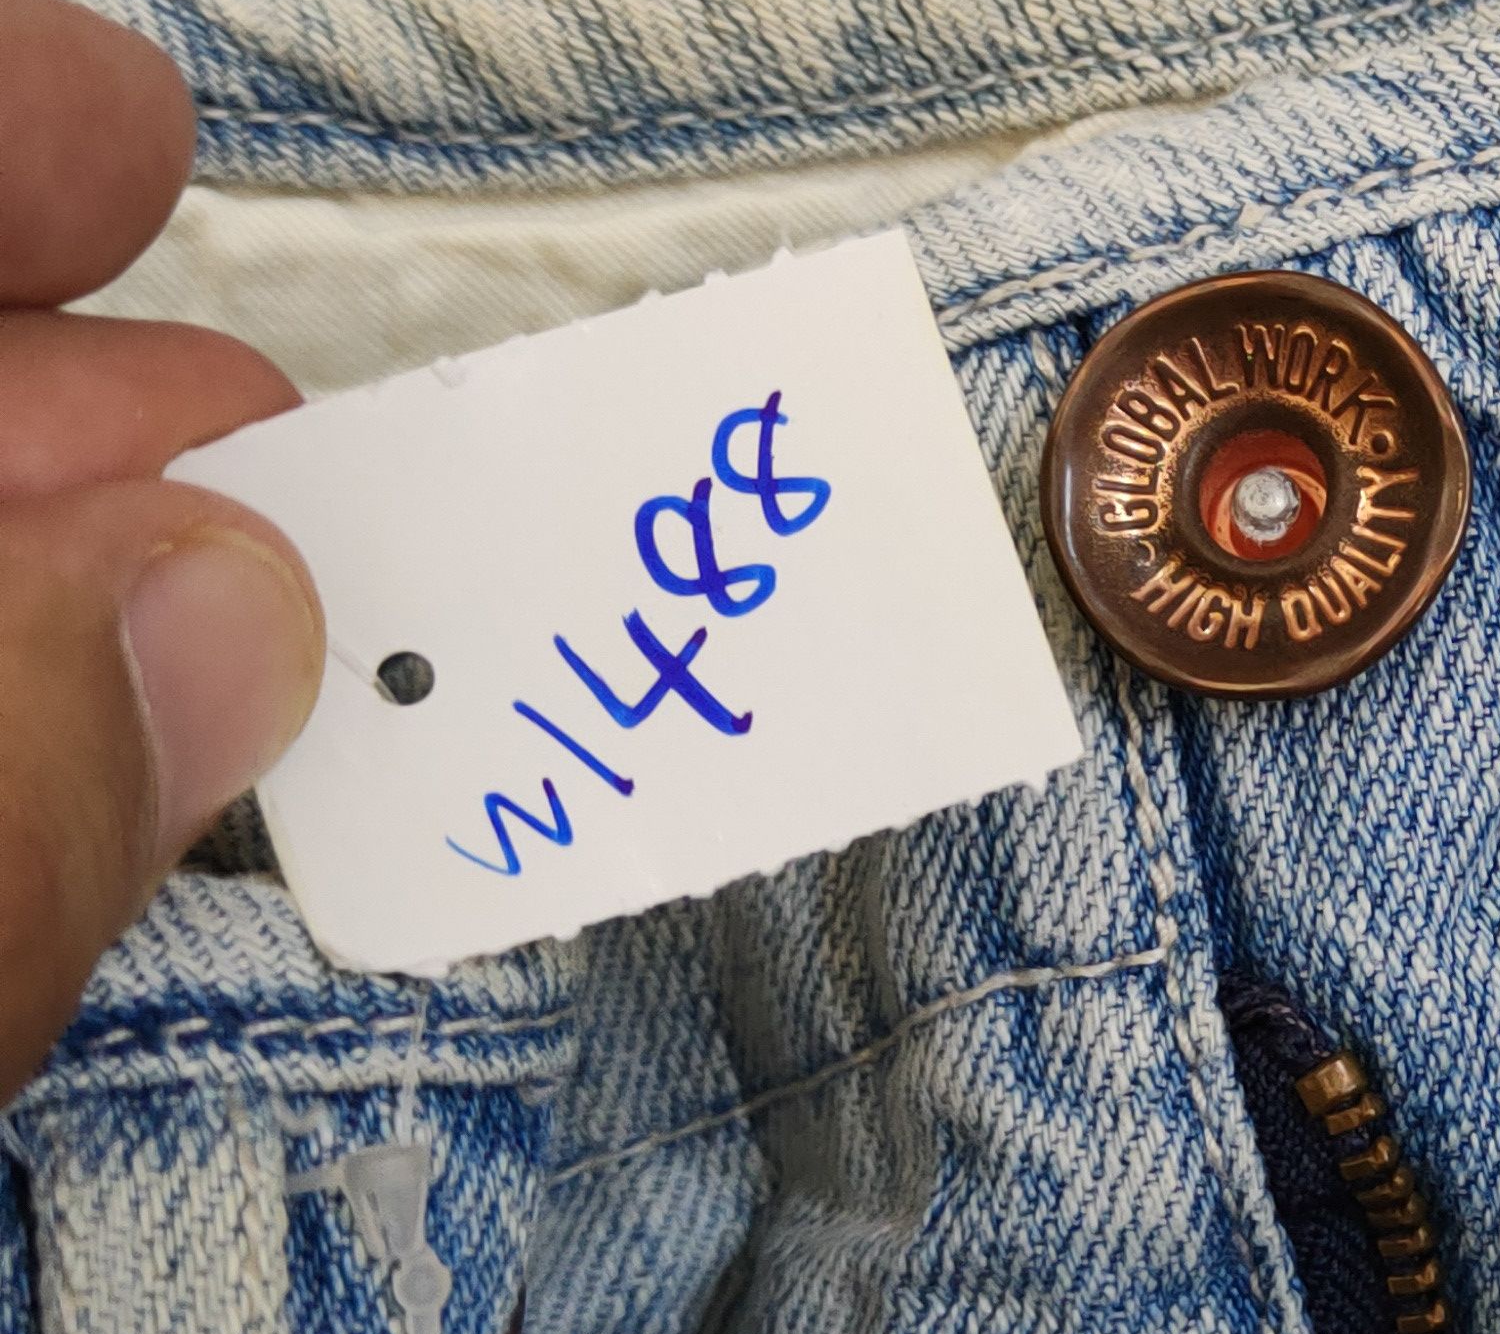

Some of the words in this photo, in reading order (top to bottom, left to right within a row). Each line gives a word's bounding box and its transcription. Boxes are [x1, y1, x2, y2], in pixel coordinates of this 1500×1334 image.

[1094, 337, 1241, 536] GLOBAL
[1235, 323, 1398, 446] WORK
[1130, 552, 1269, 650] HIGH
[1280, 466, 1420, 641] QUALITY
